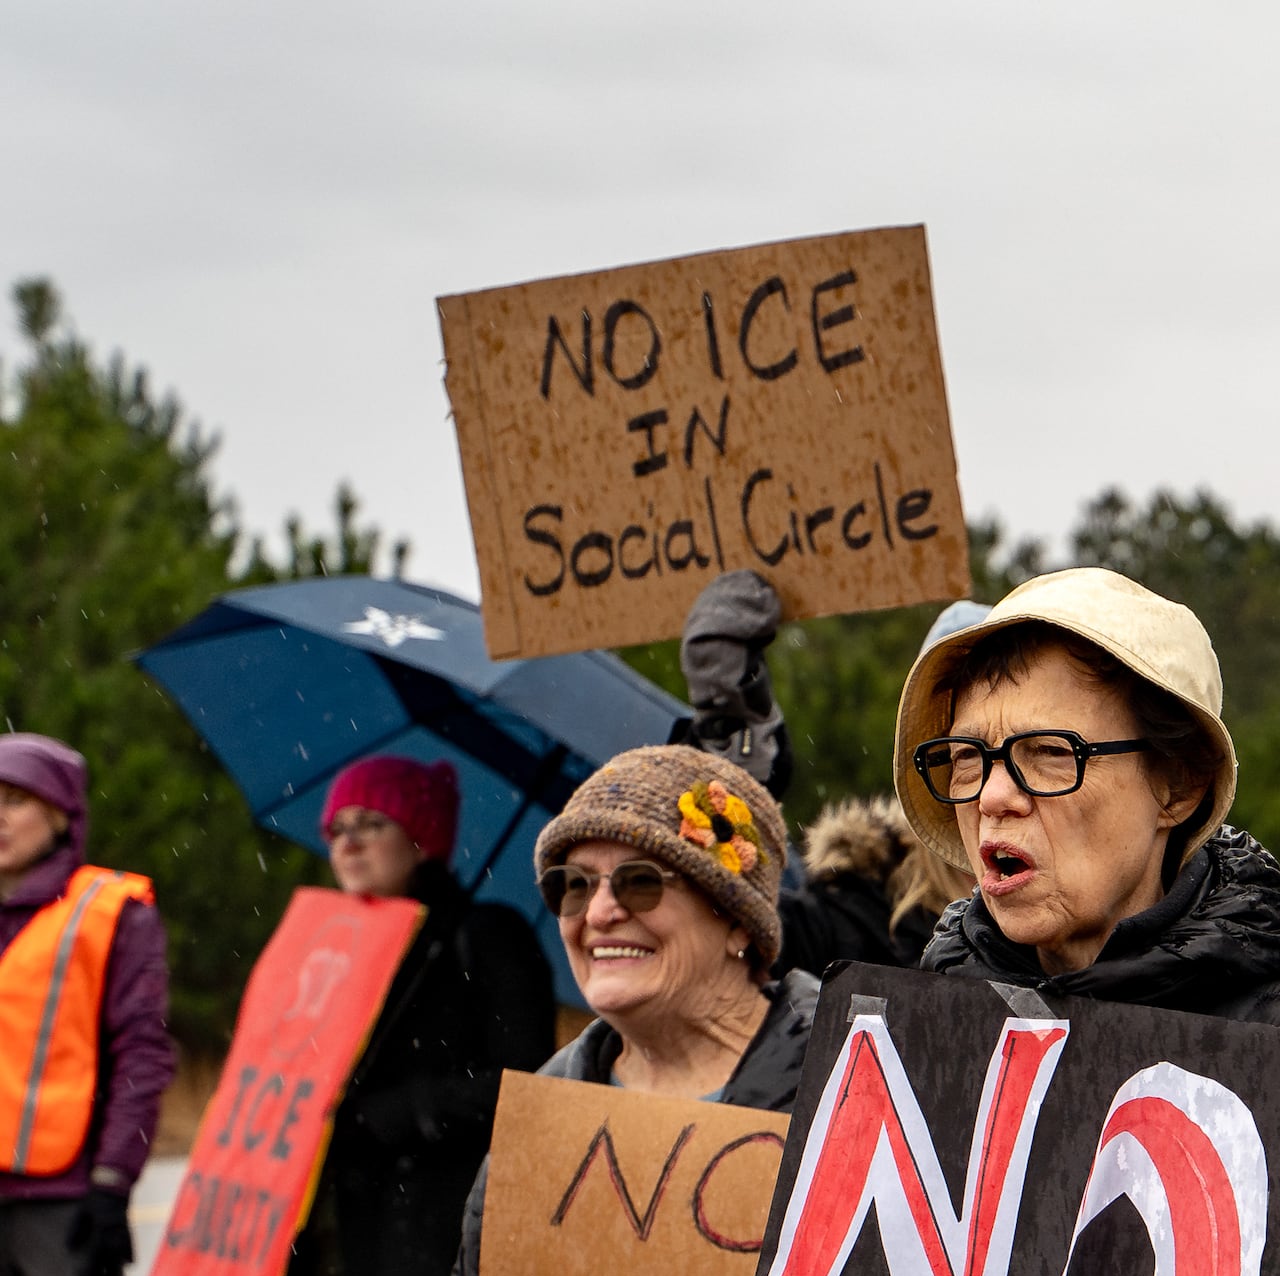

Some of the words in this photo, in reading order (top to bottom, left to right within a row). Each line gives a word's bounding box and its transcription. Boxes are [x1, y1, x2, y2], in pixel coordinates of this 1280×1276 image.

[540, 298, 664, 400] NO
[702, 270, 866, 380] ICE
[627, 395, 732, 478] IN
[522, 475, 726, 597] Social
[740, 462, 940, 567] Circle
[215, 1064, 316, 1162] ICE
[550, 1119, 787, 1254] NO
